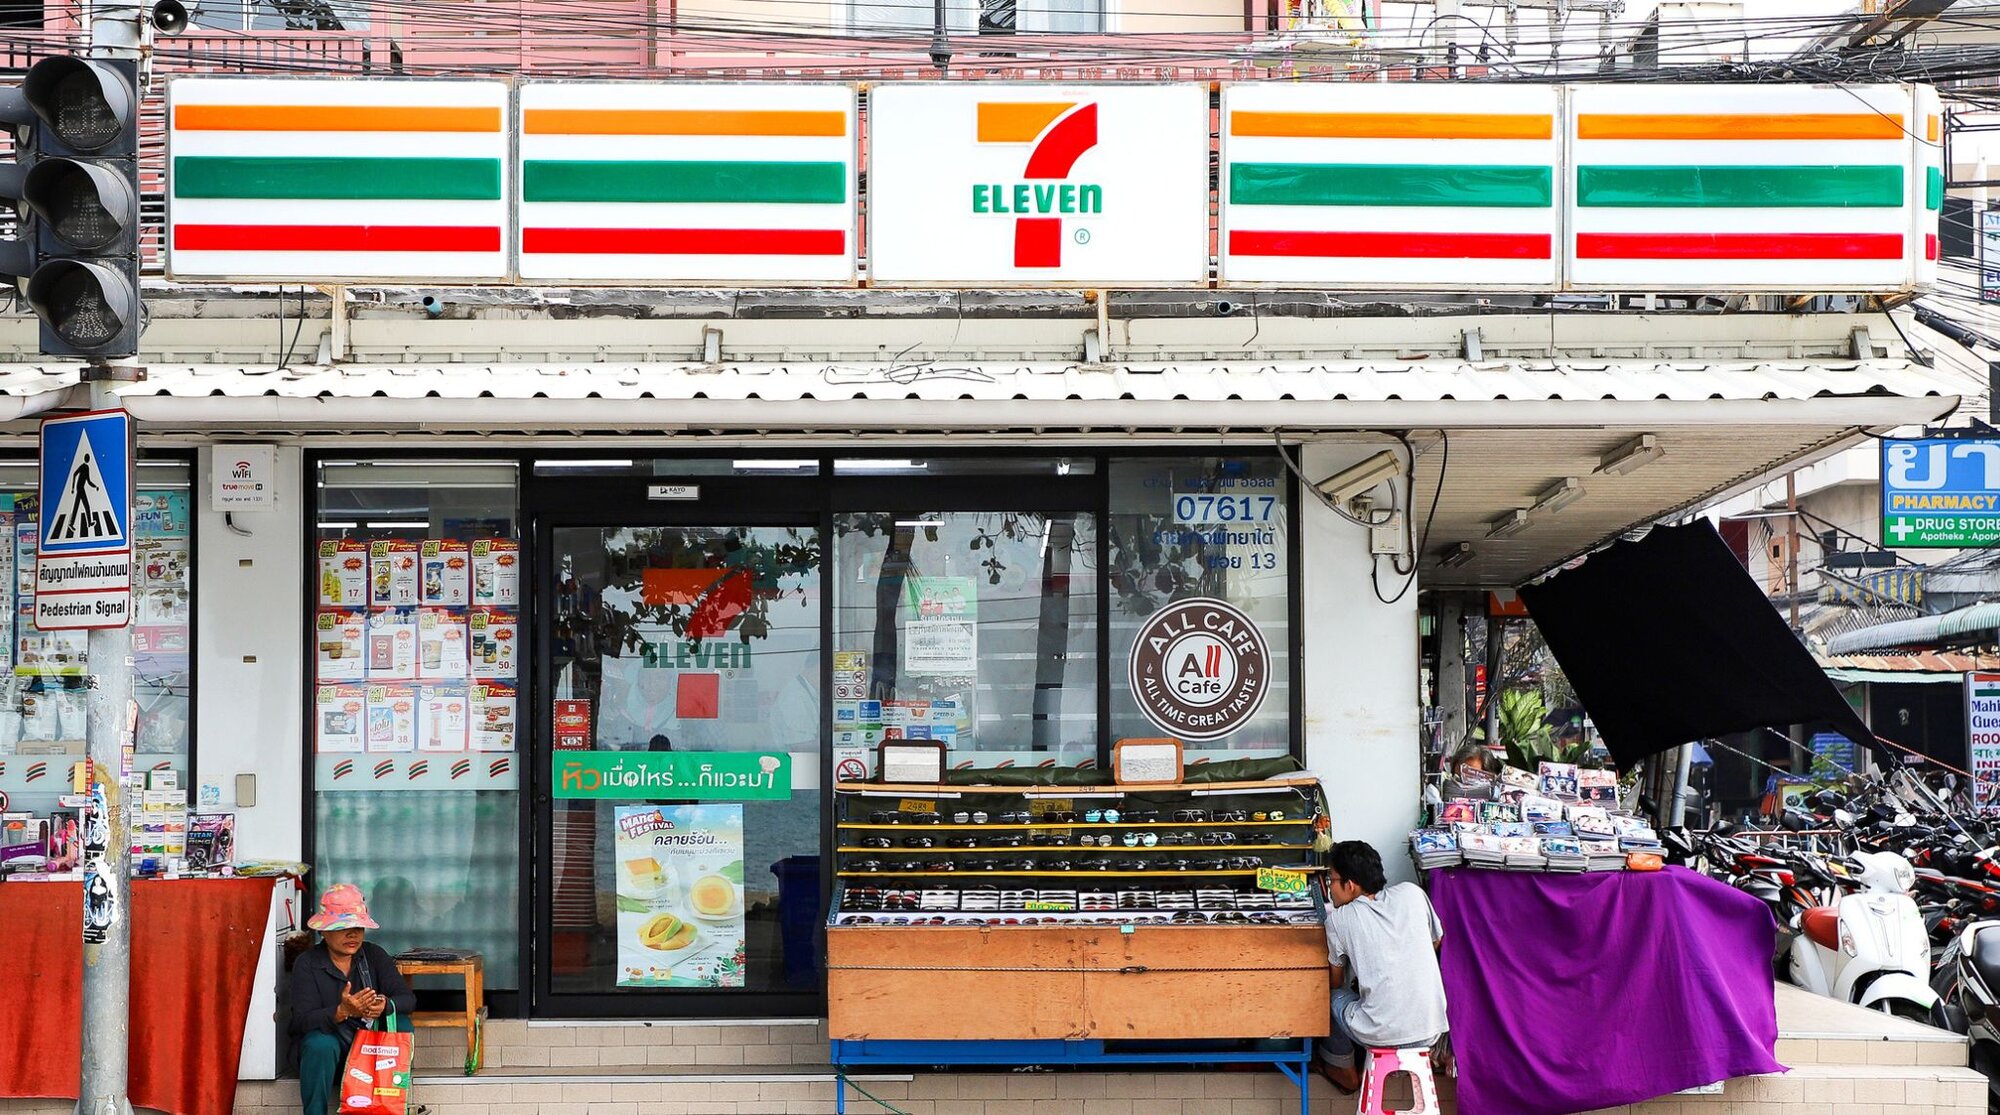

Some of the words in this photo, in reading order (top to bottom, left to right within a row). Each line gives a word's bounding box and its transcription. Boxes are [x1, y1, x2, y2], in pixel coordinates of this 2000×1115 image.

[1176, 496, 1275, 521] 07617
[1893, 495, 1998, 509] PHARMACY
[1915, 518, 1955, 531] DRUG
[1920, 532, 1965, 541] Apotheke
[1251, 553, 1276, 569] 13
[40, 561, 128, 583] สัญญาณไฟคนข้ามถนน
[40, 601, 92, 617] Pedestrian
[95, 599, 125, 617] Signal
[1149, 613, 1196, 655] ALL
[1178, 645, 1222, 678] All
[1178, 679, 1221, 694] Café
[1144, 677, 1157, 701] ALL
[1157, 698, 1186, 724] TIME
[1188, 708, 1230, 727] GREAT
[1229, 678, 1257, 713] TASTE
[629, 821, 674, 839] FESTIVAL
[1259, 876, 1306, 892] 250
